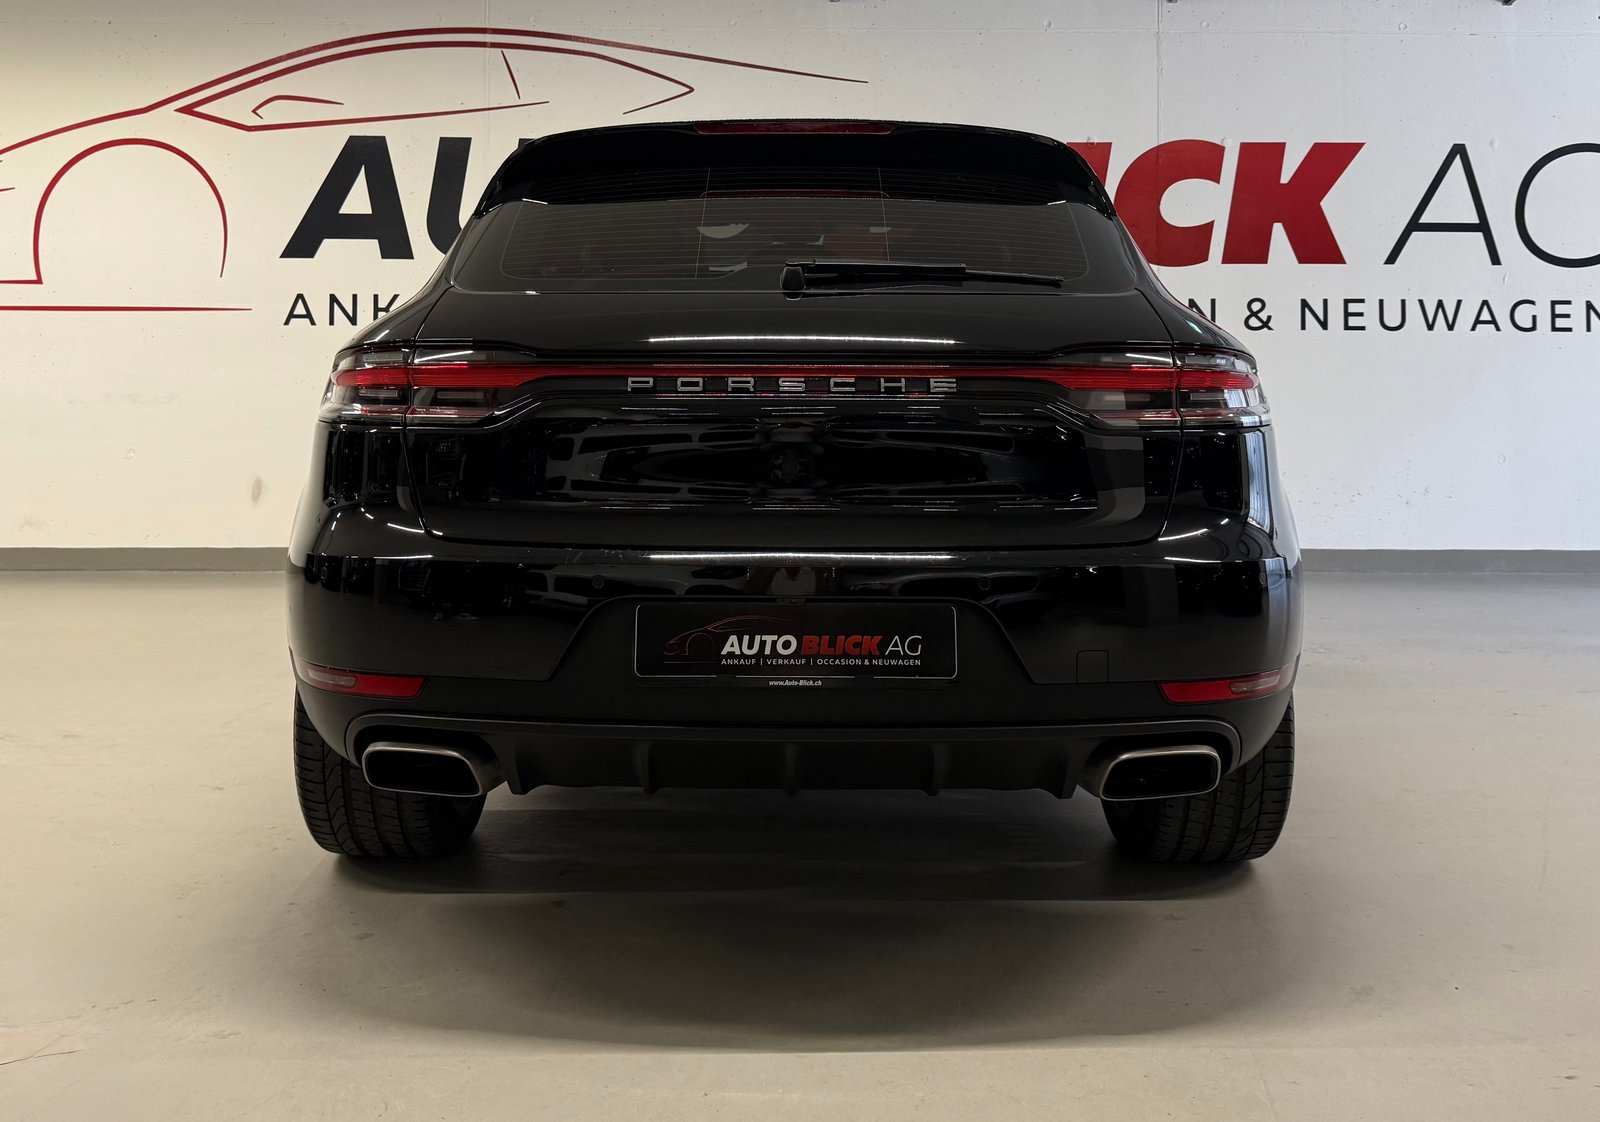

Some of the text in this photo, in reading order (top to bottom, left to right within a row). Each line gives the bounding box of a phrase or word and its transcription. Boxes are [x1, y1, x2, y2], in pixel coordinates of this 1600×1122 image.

[1067, 139, 1361, 267] CK
[1243, 298, 1274, 331] &
[628, 377, 956, 392] PORSCHE
[721, 635, 922, 656] AUTO BLICK AG
[721, 658, 921, 667] ANKAUF VERKAUF OCCASION & NEUWAGEN
